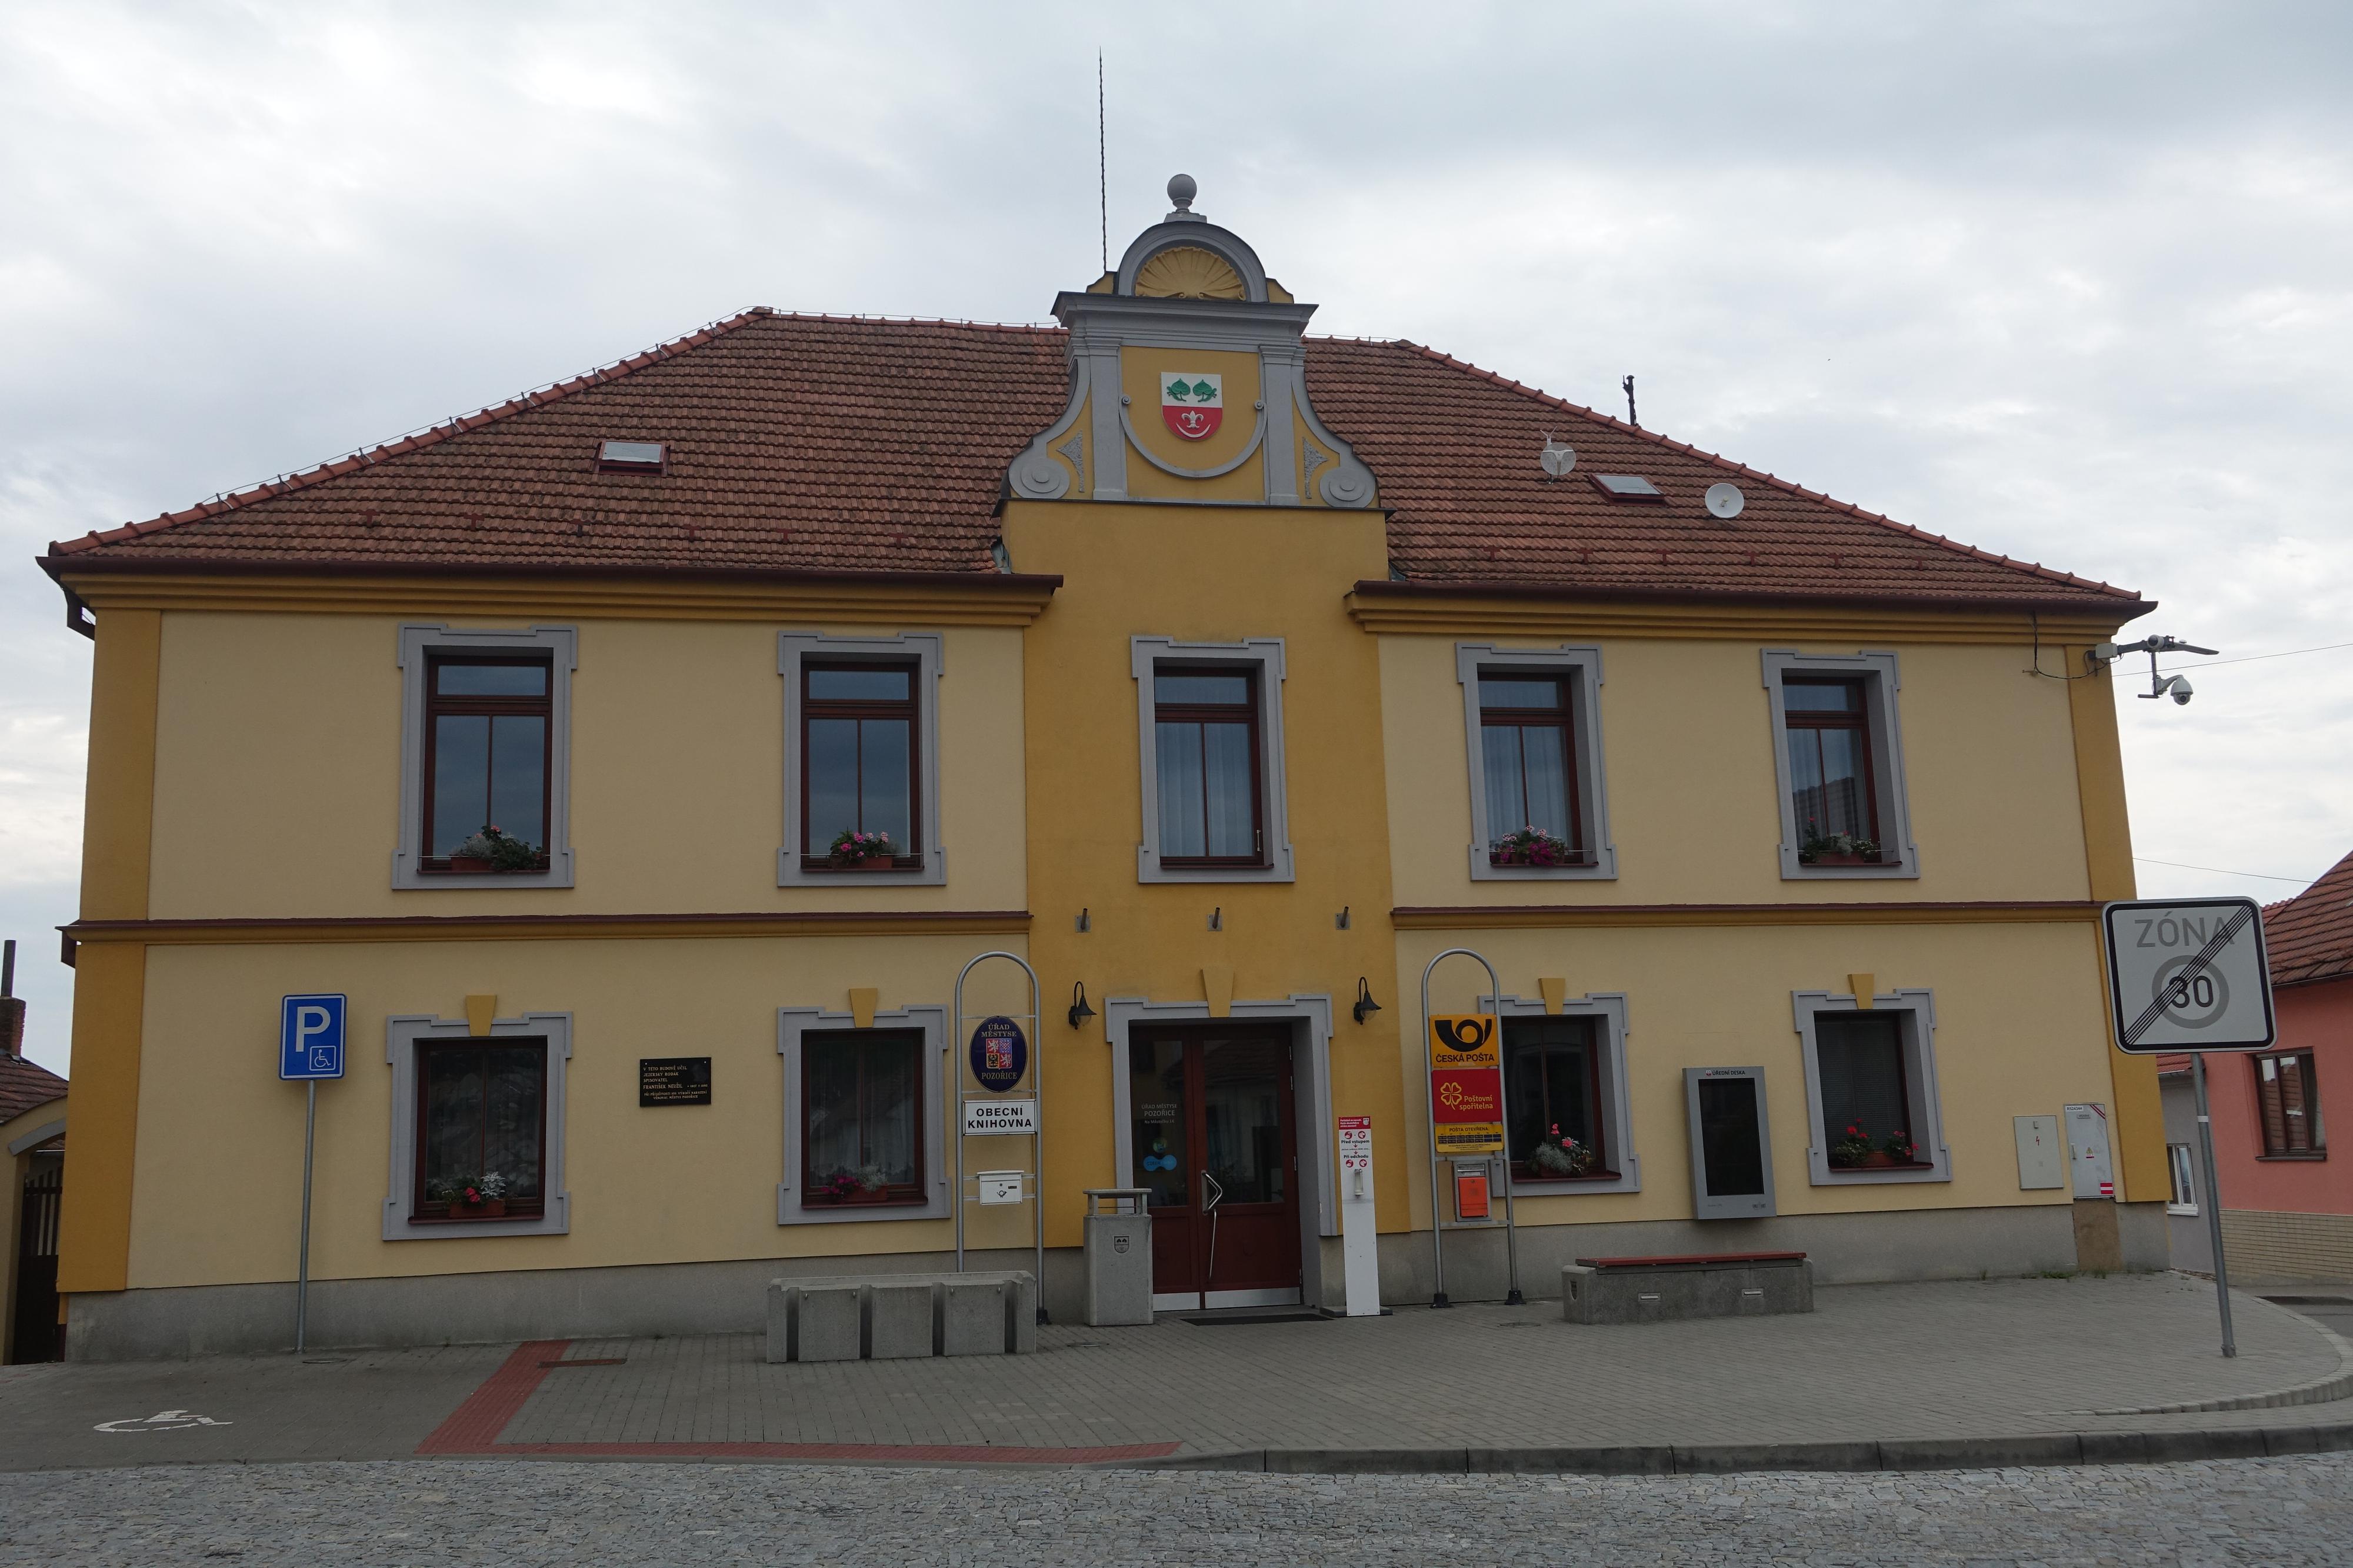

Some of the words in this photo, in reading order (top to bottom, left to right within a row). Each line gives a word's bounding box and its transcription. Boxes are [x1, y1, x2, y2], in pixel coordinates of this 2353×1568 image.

[2134, 911, 2235, 948] ZÓNA
[2169, 975, 2214, 1008] 30
[295, 1006, 331, 1052] P
[1436, 1053, 1464, 1062] ČESKÁ
[1466, 1052, 1494, 1062] POŠTA
[981, 1071, 1017, 1080] POZOŘICE
[976, 1105, 1023, 1116] OBECNÍ
[1459, 1102, 1493, 1111] spořitelna
[968, 1119, 1032, 1129] KNIHOVNA
